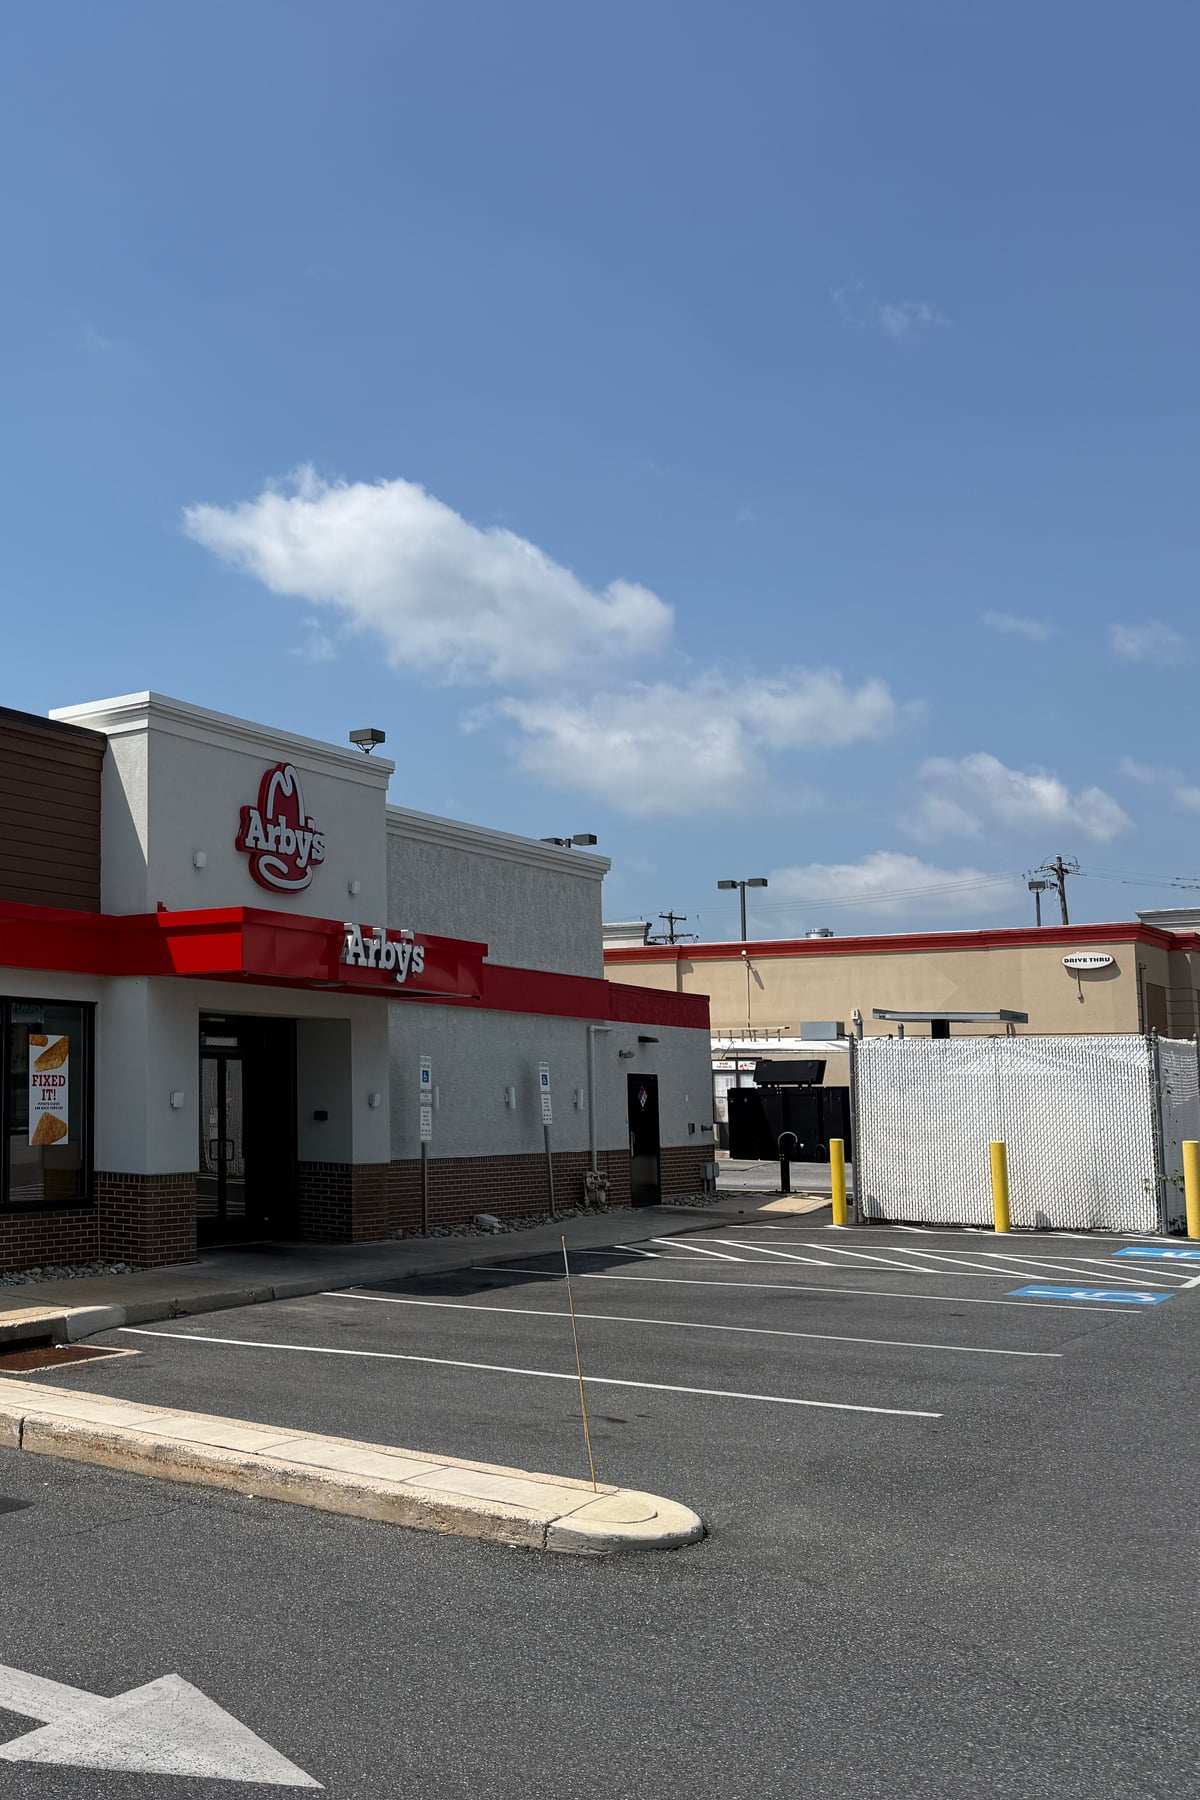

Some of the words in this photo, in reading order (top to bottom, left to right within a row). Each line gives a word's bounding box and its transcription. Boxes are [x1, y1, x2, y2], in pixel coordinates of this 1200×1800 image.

[245, 809, 326, 868] Arby's
[344, 923, 425, 983] Arby's
[31, 1074, 66, 1087] FIXED
[41, 1088, 57, 1101] IT!
